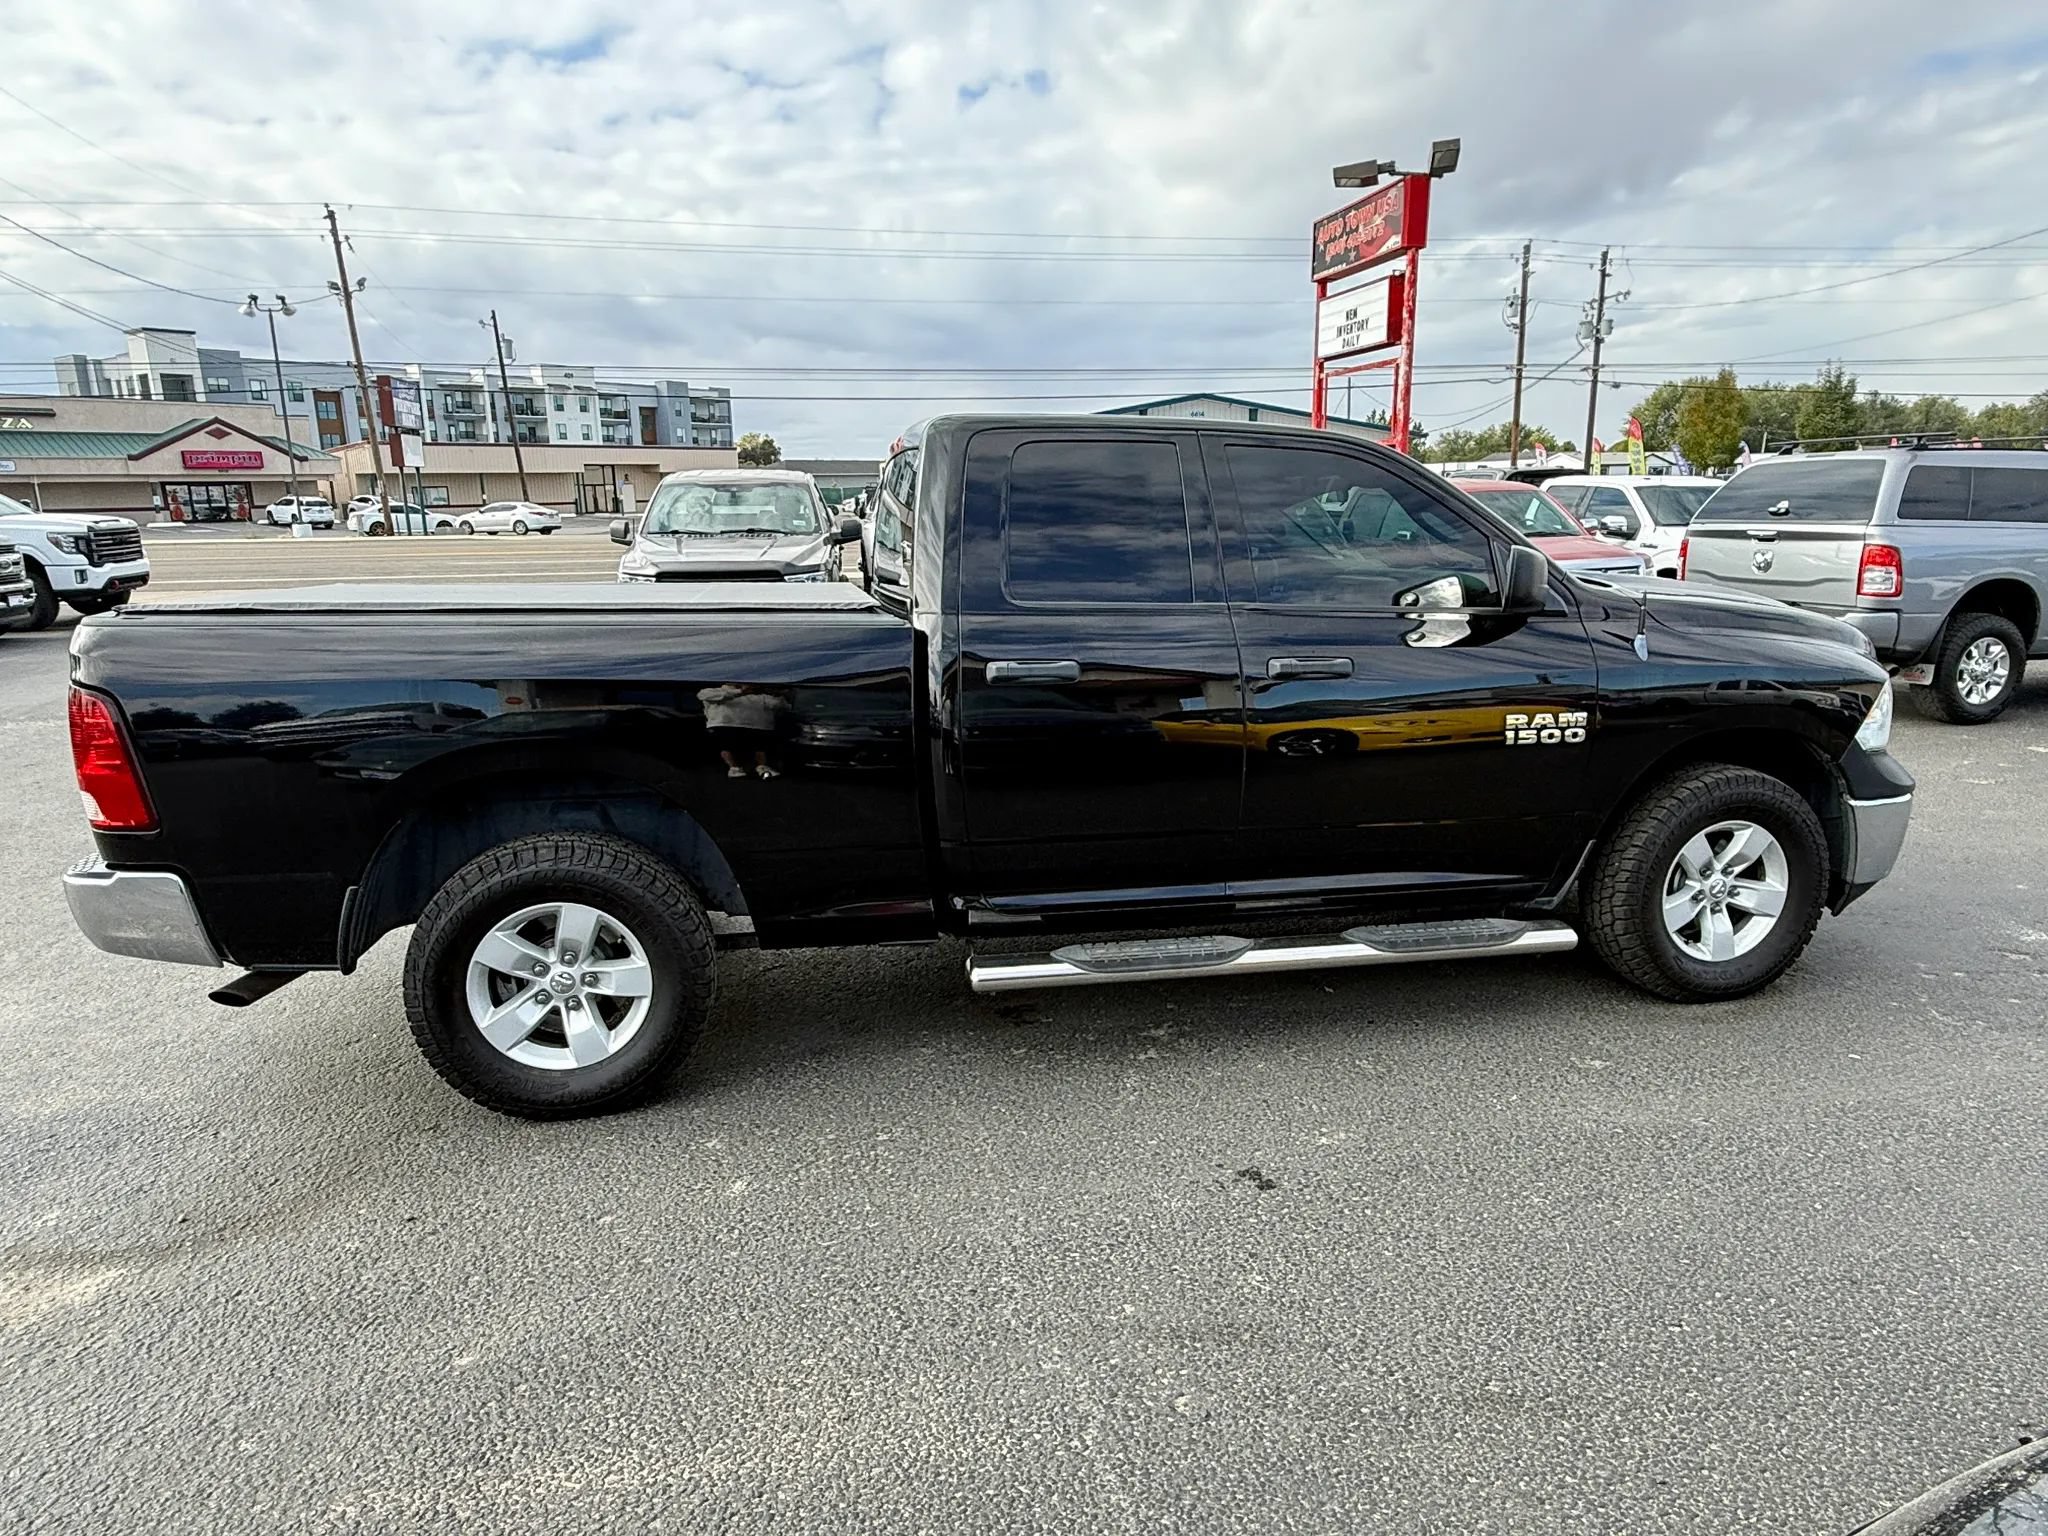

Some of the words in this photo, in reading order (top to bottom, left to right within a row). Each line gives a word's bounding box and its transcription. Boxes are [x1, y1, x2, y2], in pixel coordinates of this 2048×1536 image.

[1317, 218, 1344, 246] AUTO
[1345, 202, 1376, 232] TOWN
[1376, 192, 1399, 215] USA
[1336, 317, 1369, 338] INVENTORY
[1342, 334, 1360, 349] DAILY
[1505, 712, 1588, 729] RAM
[1505, 728, 1586, 745] 1500
